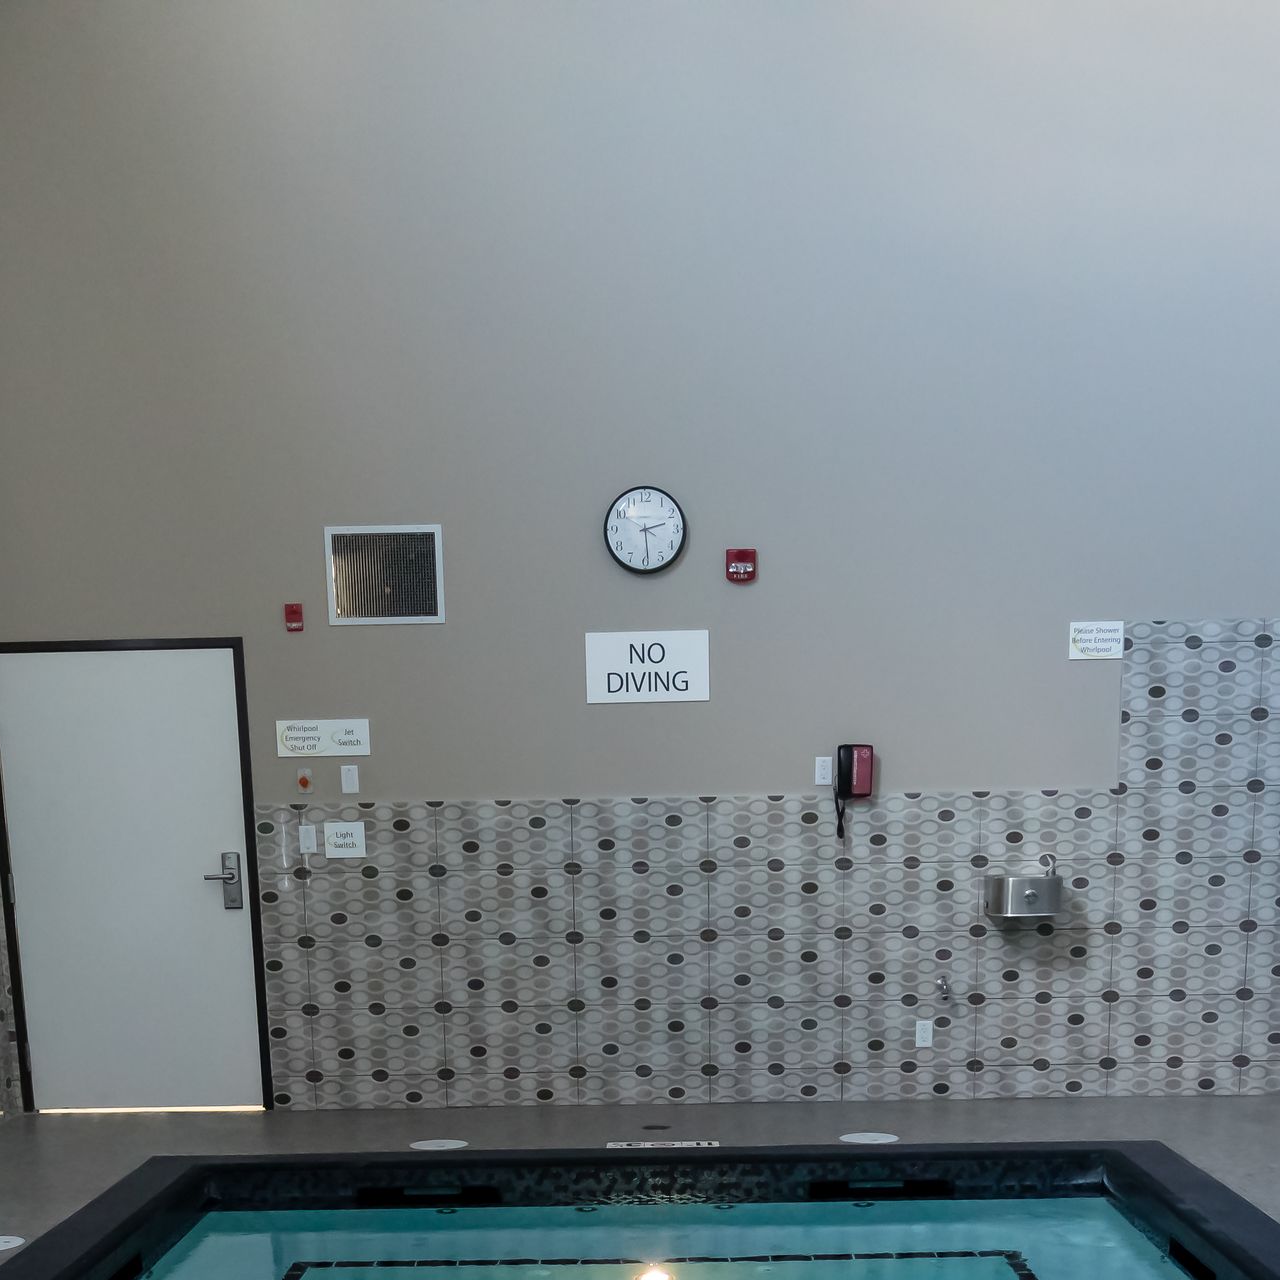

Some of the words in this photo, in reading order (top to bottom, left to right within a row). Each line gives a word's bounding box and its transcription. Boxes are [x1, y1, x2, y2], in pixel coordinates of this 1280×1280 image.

[639, 491, 652, 503] 12
[616, 508, 626, 520] 10
[668, 508, 676, 519] 2
[610, 525, 618, 536] 9
[672, 524, 680, 534] 3
[615, 540, 623, 552] 8
[627, 552, 634, 563] 7
[657, 551, 664, 562] 5
[628, 642, 666, 664] NO
[1080, 646, 1112, 654] Whirlpool
[606, 670, 689, 694] DIVING
[286, 725, 319, 734] Whirlpool
[344, 728, 354, 736] Jet
[284, 734, 321, 743] Emergency
[338, 738, 361, 746] Switch
[289, 744, 306, 752] Shut
[306, 743, 318, 751] Off
[335, 831, 354, 840] Light
[333, 840, 357, 848] Switch
